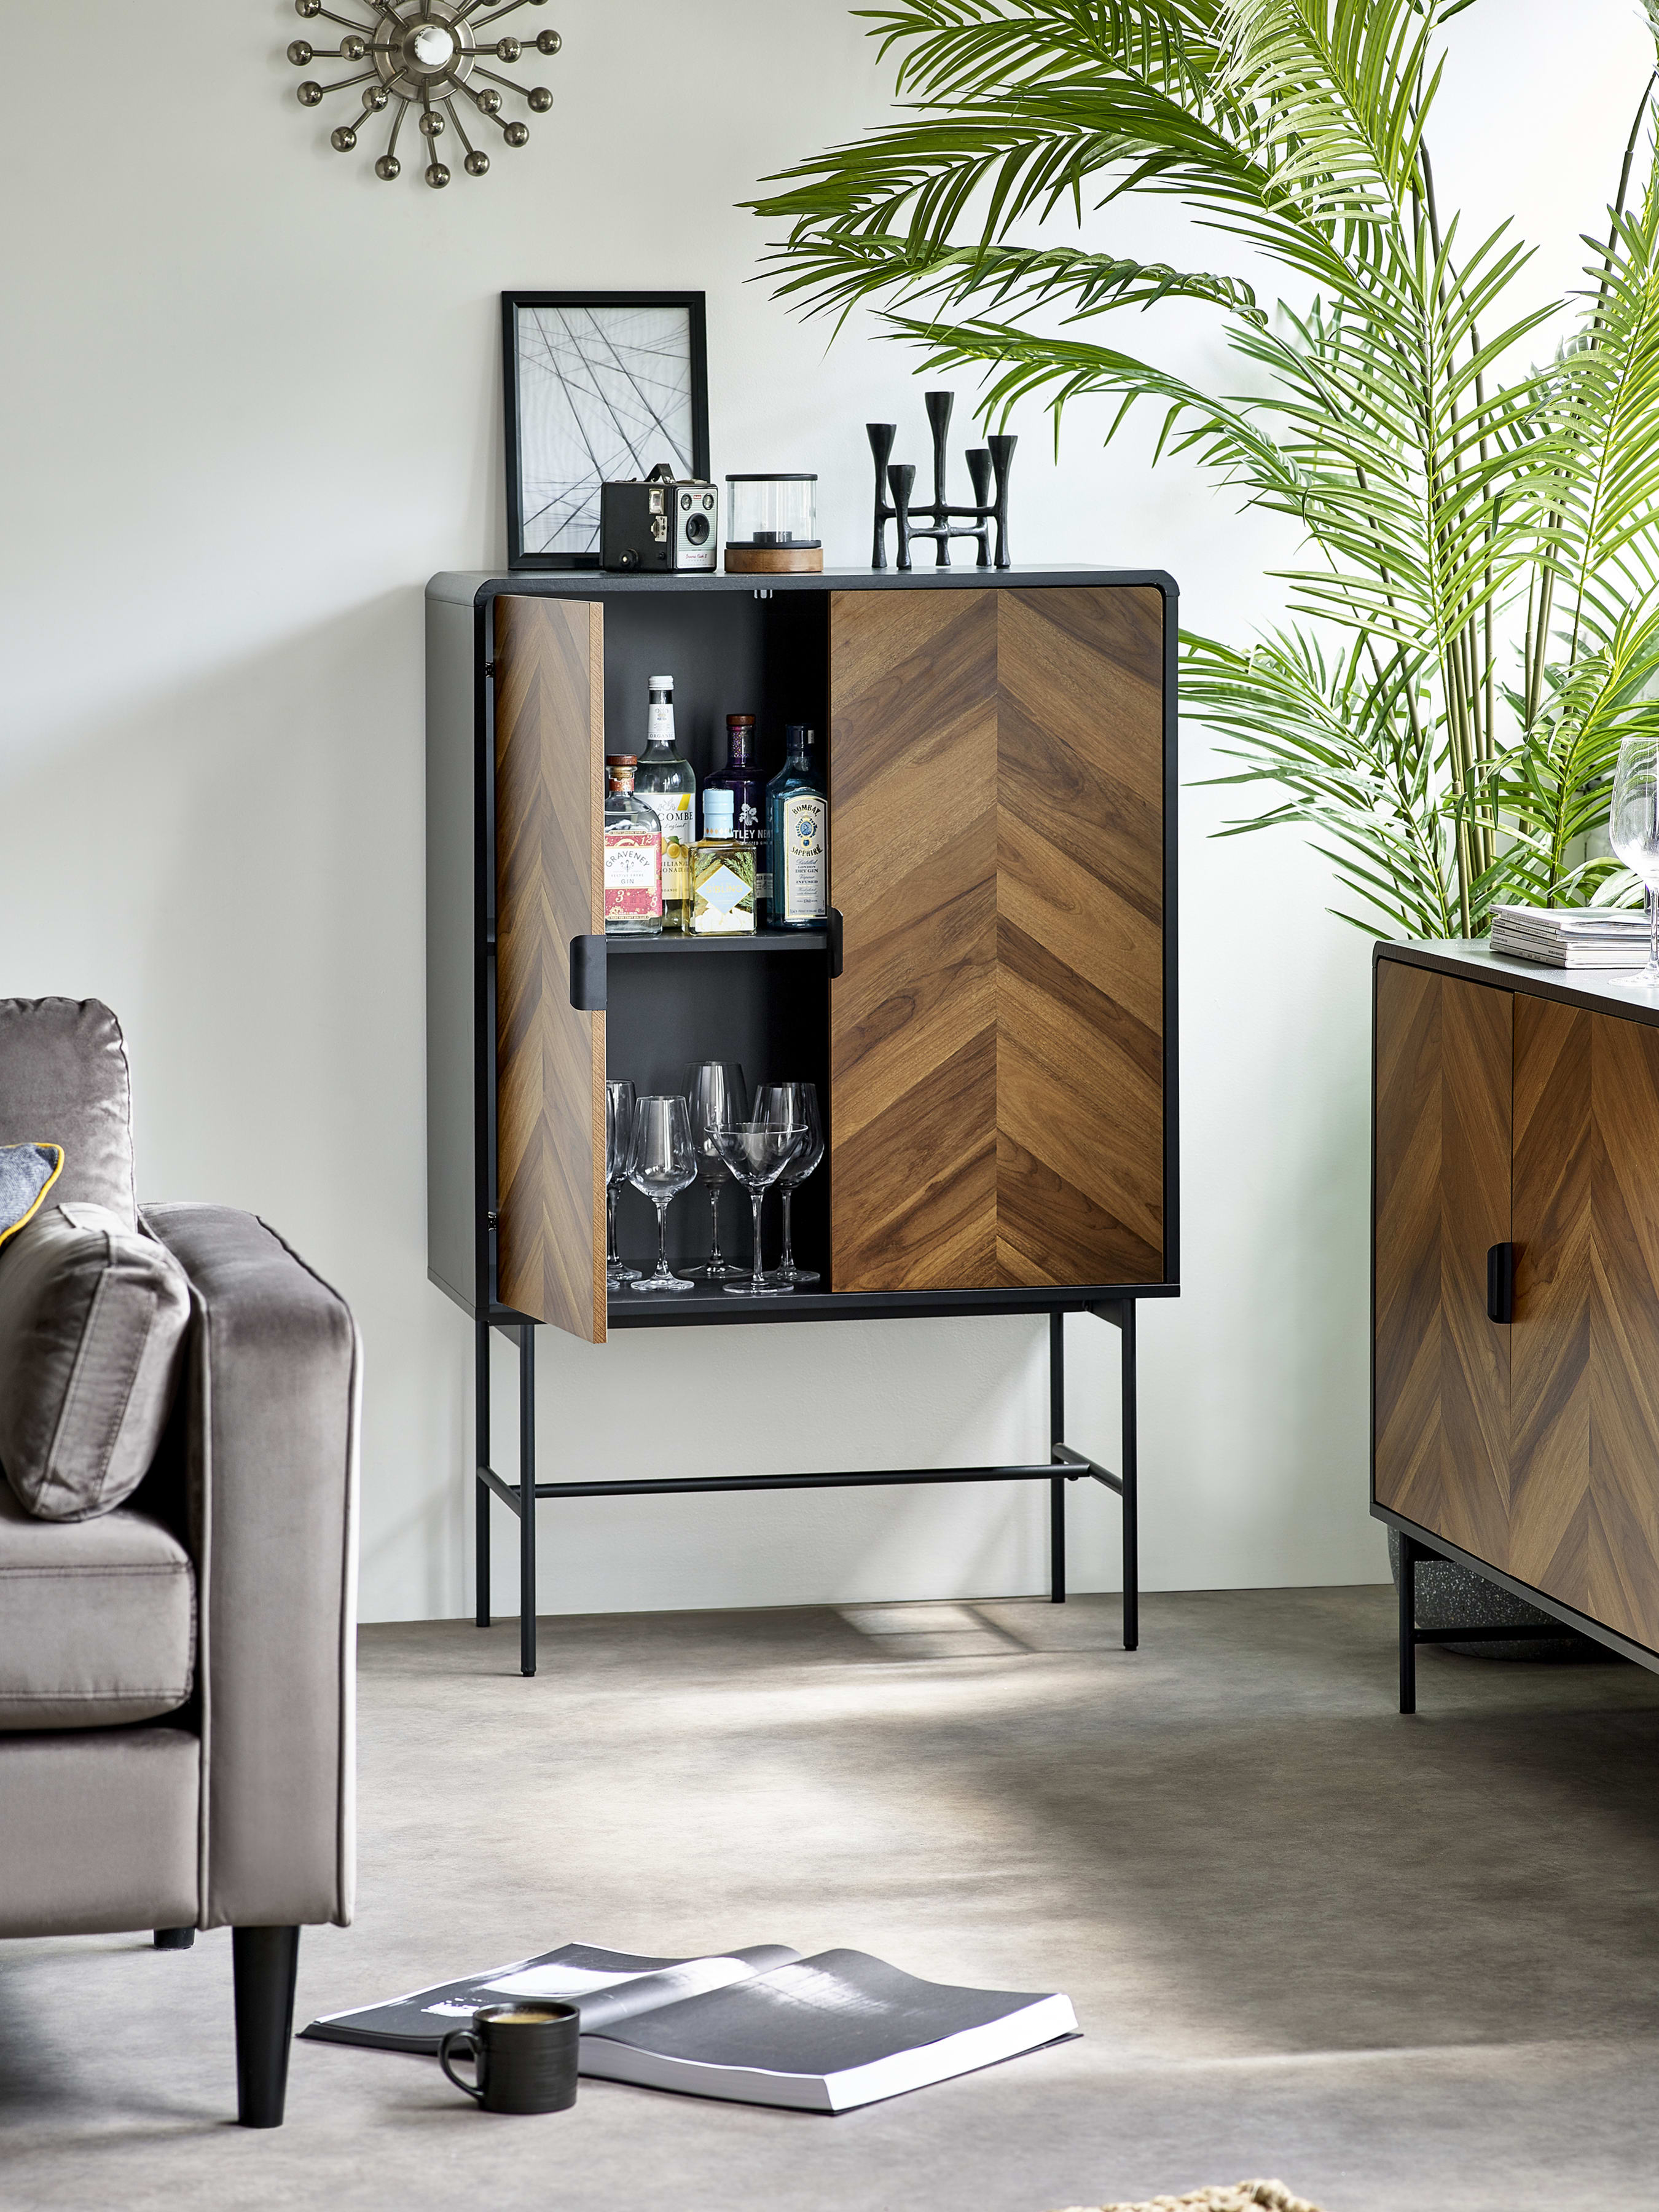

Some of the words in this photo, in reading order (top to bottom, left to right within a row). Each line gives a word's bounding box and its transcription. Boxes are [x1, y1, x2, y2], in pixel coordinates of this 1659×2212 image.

[791, 804, 821, 817] BOMBAY
[657, 812, 693, 822] COMBE
[640, 834, 653, 846] 12
[732, 830, 755, 839] TLEY
[790, 844, 823, 857] SAPPHIRE
[605, 850, 650, 868] GRAVENEY
[615, 889, 625, 903] 3
[650, 896, 657, 908] 8
